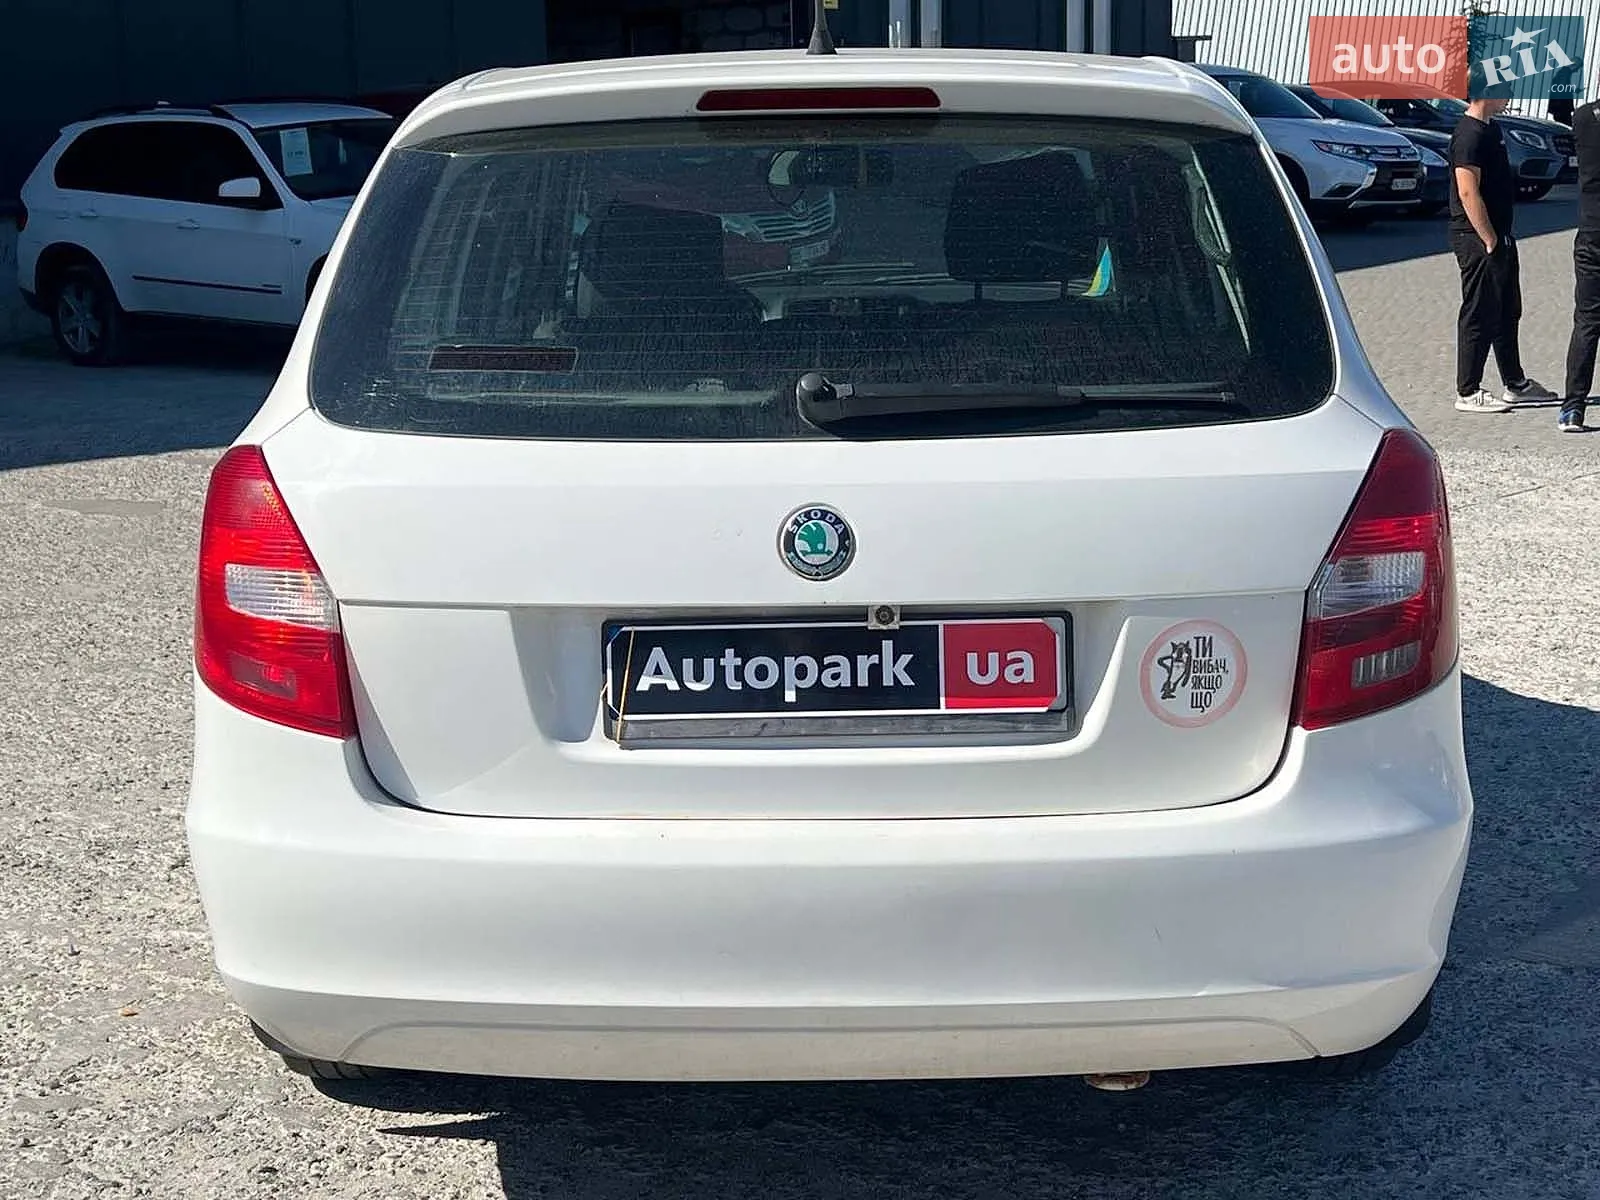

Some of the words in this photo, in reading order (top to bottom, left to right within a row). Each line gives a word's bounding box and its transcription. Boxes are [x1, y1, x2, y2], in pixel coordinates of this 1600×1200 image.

[1193, 635, 1213, 658] ТИ
[636, 639, 915, 702] Autopark
[966, 650, 1035, 685] ua
[1191, 674, 1222, 693] ЯКЩО
[1190, 691, 1212, 713] ЩО
